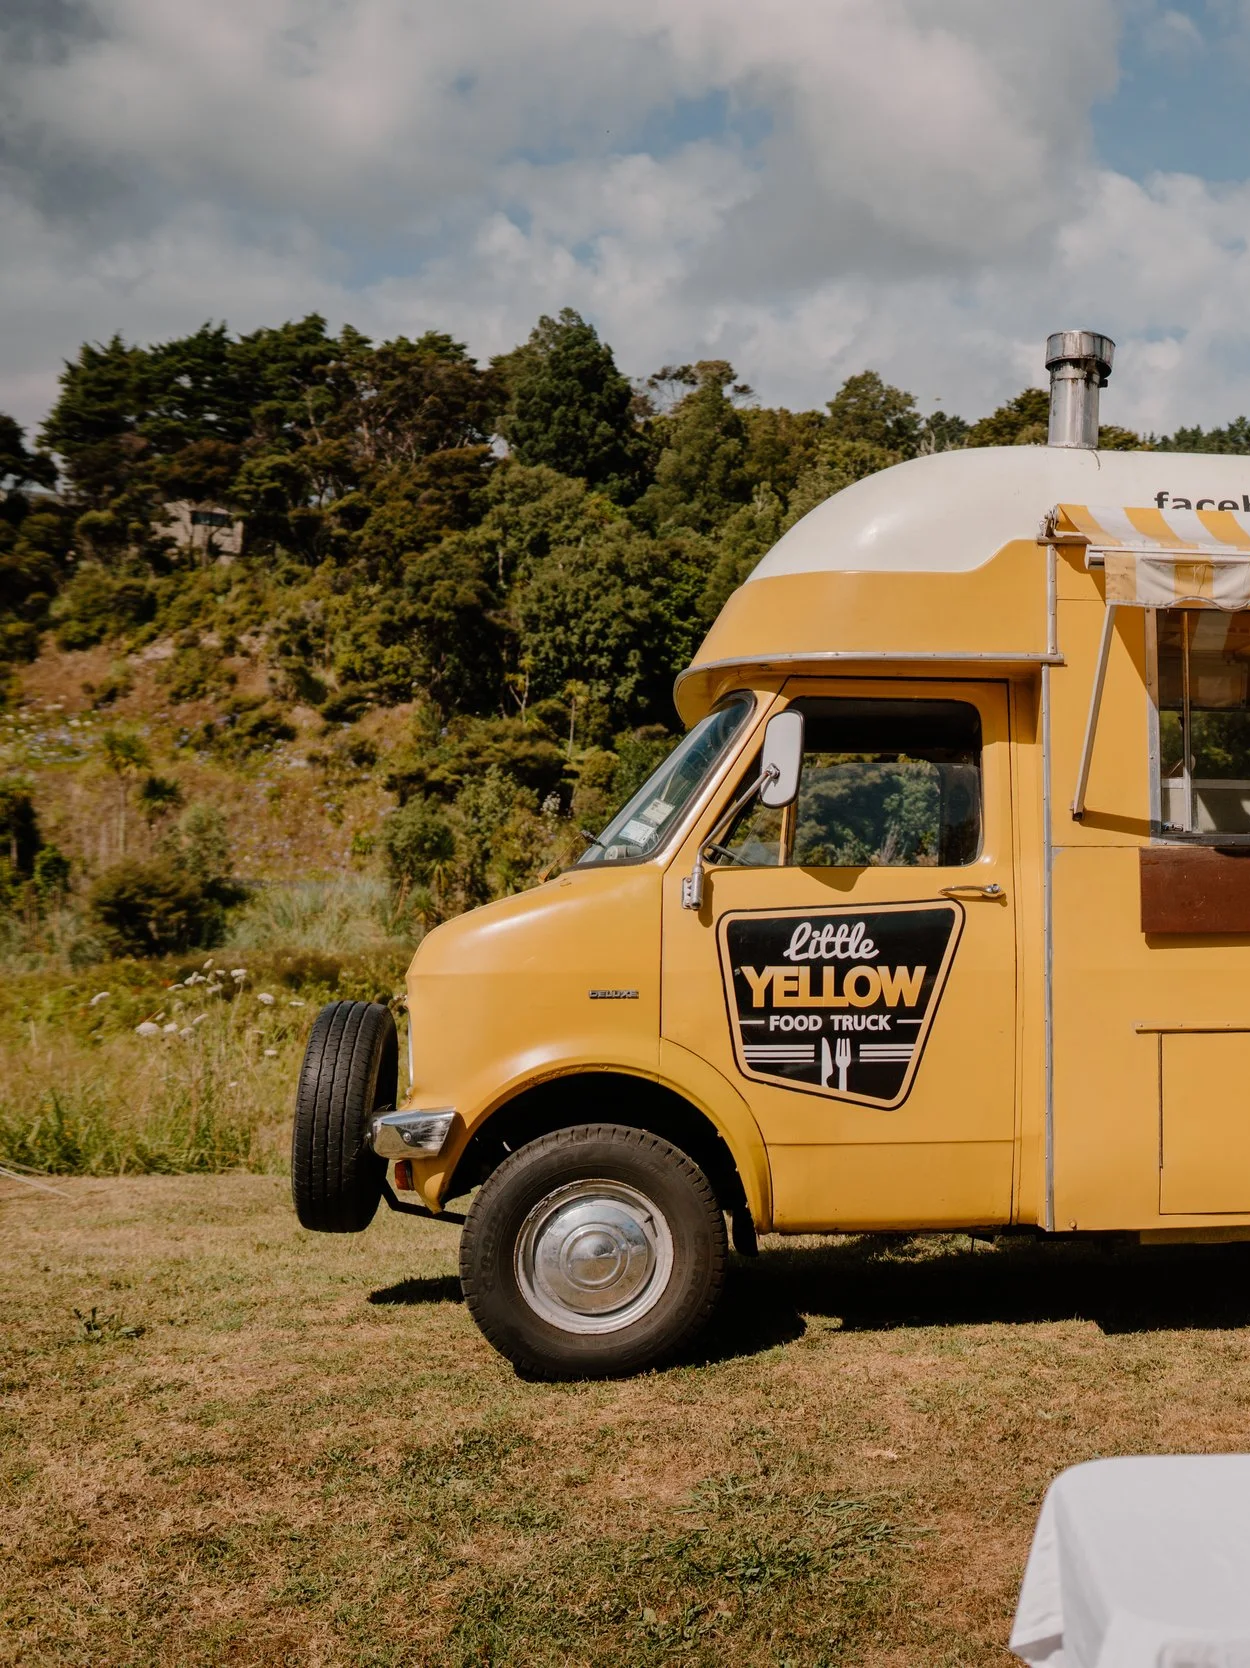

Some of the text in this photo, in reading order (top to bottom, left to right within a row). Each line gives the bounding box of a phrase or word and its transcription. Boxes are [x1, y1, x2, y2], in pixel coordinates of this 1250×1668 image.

[783, 921, 880, 962] Little
[589, 989, 640, 999] DELUXE
[740, 965, 927, 1009] YELLOW
[769, 1014, 891, 1031] FOOD TRUCK
